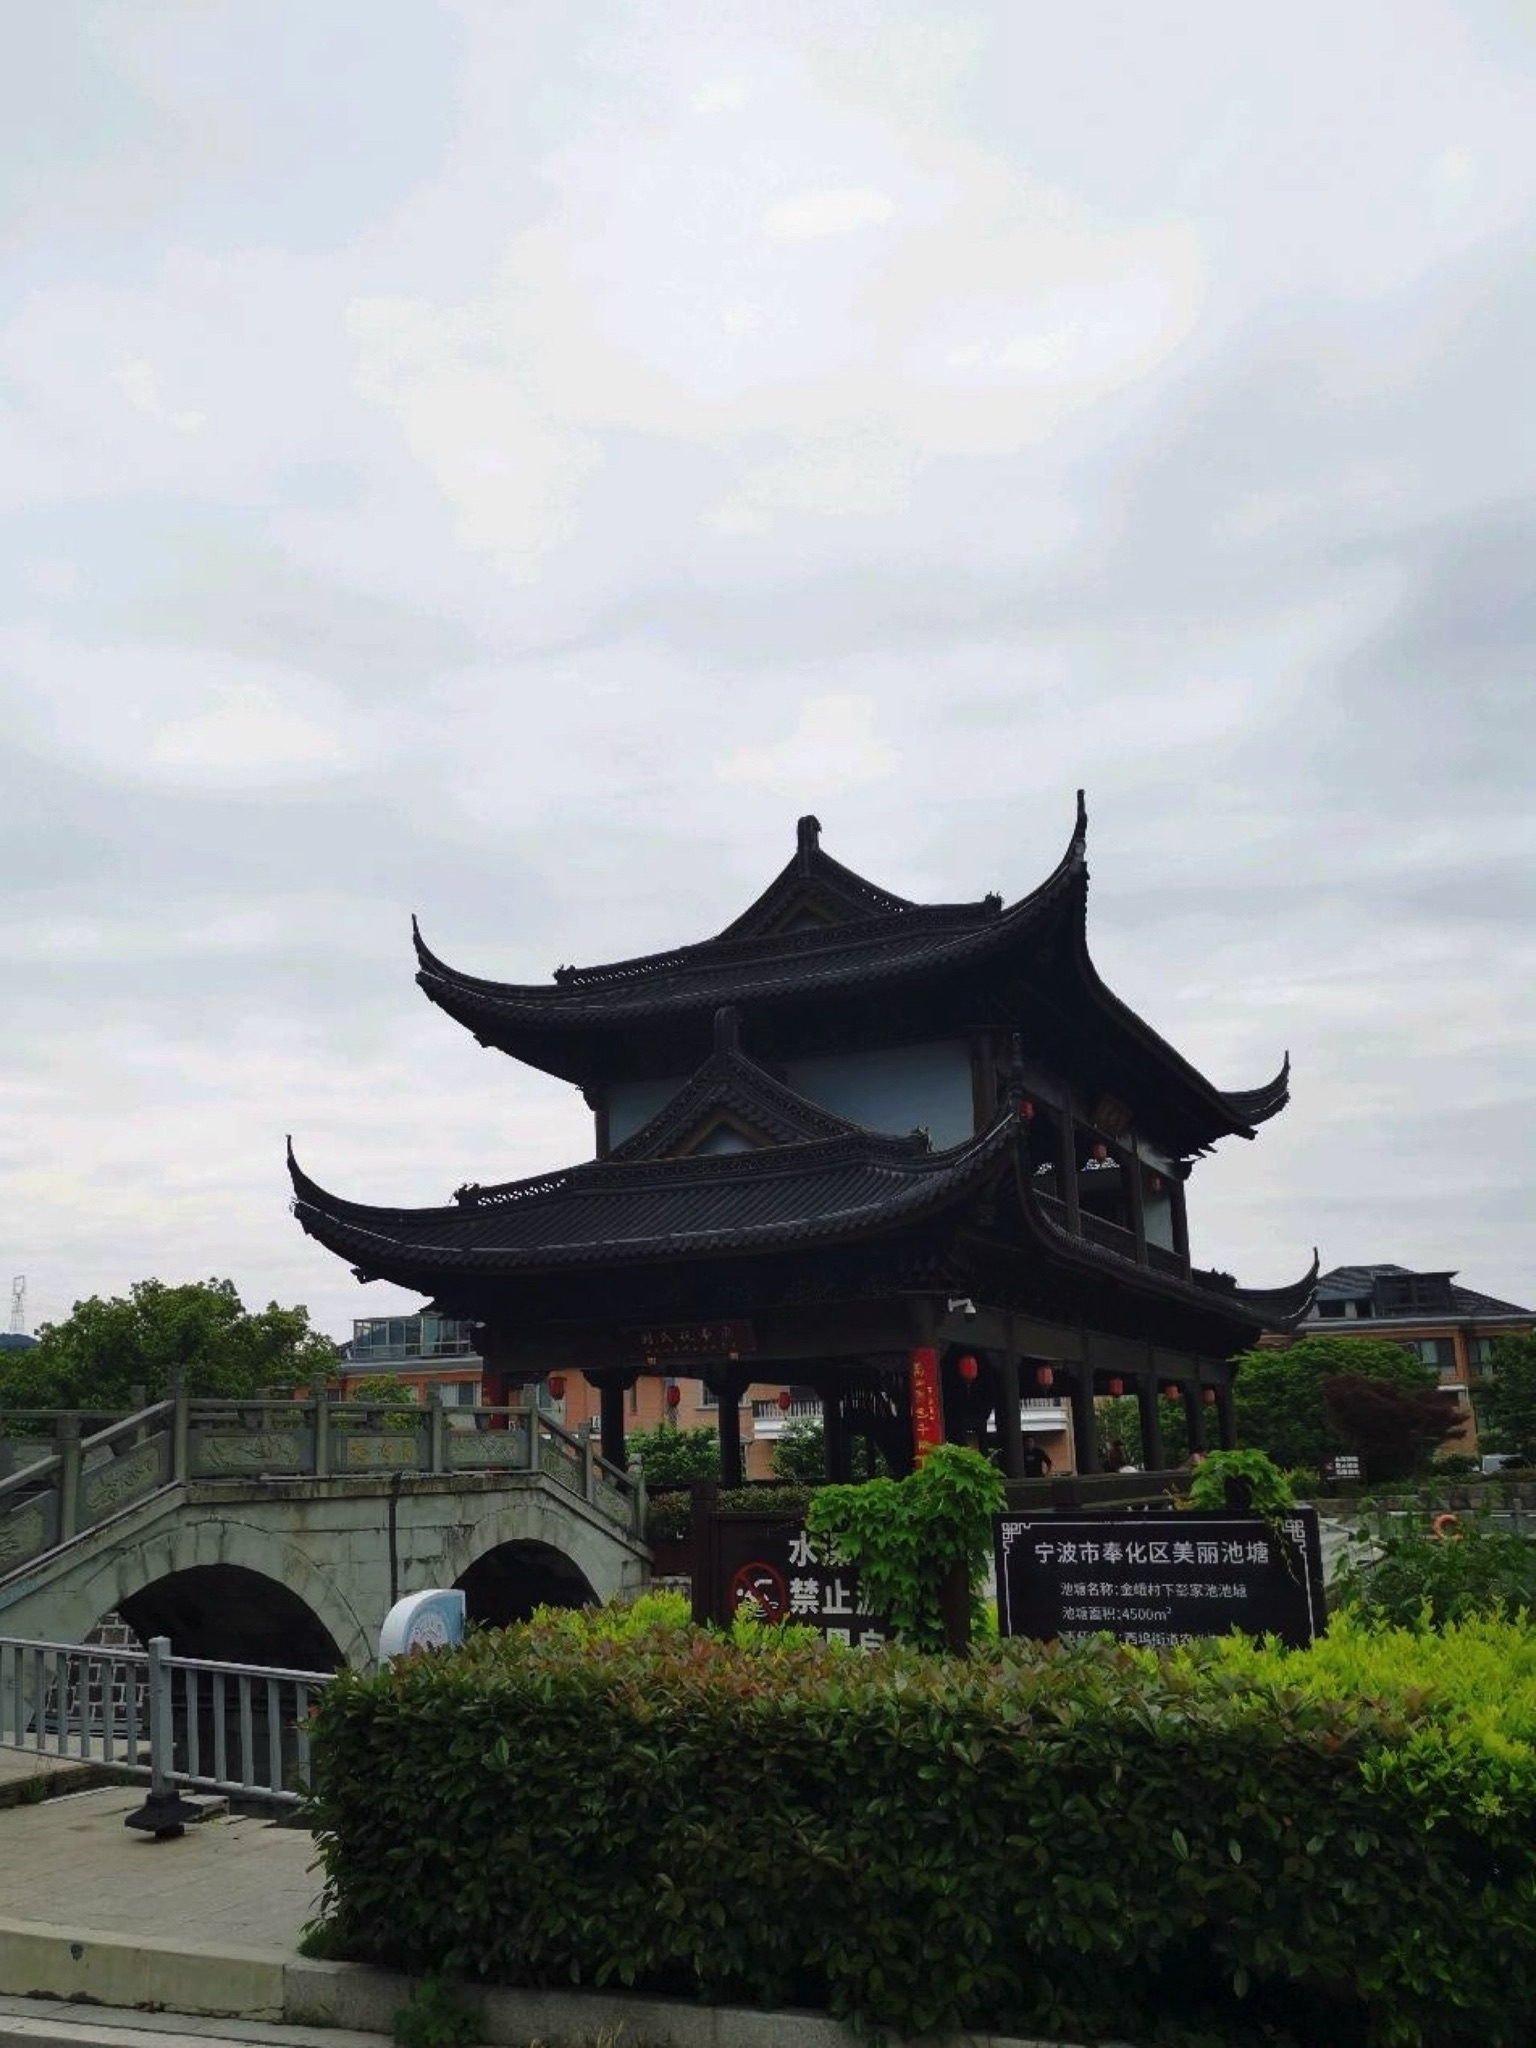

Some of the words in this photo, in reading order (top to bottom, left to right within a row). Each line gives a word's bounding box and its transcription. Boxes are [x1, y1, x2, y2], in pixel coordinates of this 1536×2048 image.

[1034, 1541, 1269, 1565] 宁波市奉化区美丽池塘
